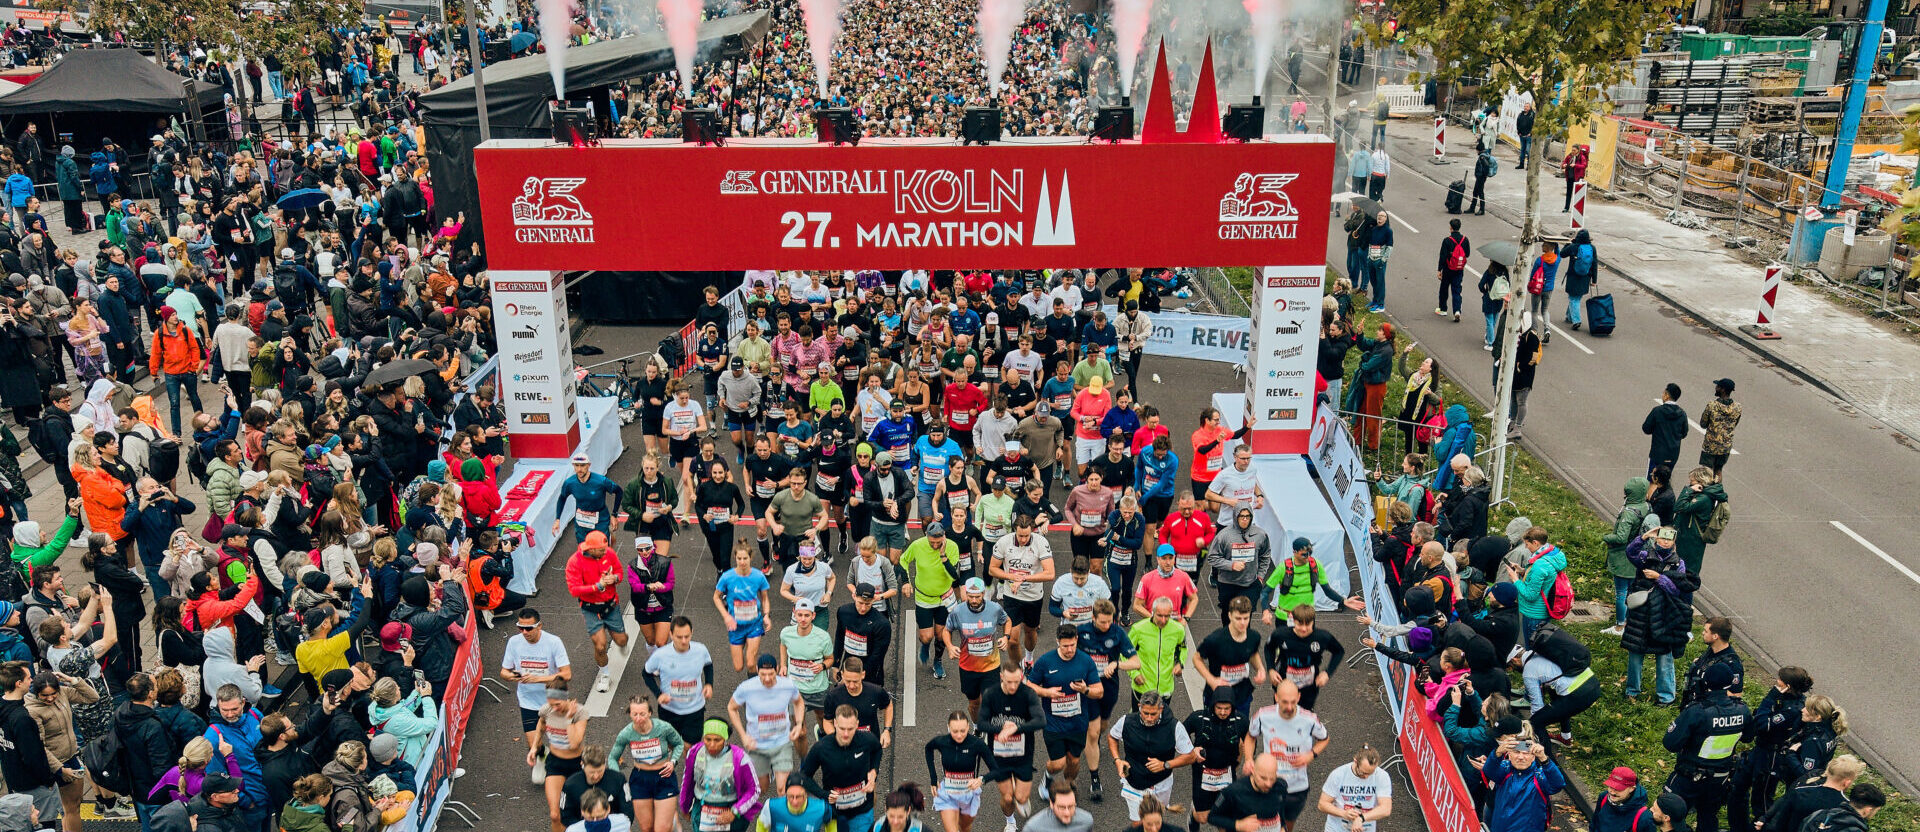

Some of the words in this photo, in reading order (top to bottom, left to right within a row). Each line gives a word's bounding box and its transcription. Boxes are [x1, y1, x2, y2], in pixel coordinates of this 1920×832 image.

[760, 170, 887, 194] GENERALI
[895, 169, 1023, 214] KÖLN
[780, 212, 840, 248] 27.
[857, 222, 1023, 247] MARATHON
[1218, 224, 1298, 240] GENERALI
[515, 227, 595, 244] GENERALI
[1281, 278, 1318, 286] GENERALI
[508, 283, 545, 291] GENERALI
[1192, 327, 1250, 351] REWE
[1277, 370, 1305, 378] pixum
[514, 392, 542, 401] REWE
[1266, 388, 1293, 397] REWE
[532, 414, 548, 423] AWB
[1280, 410, 1295, 419] AWB
[1712, 715, 1744, 728] POLIZEI
[1340, 786, 1377, 795] WINGMAN
